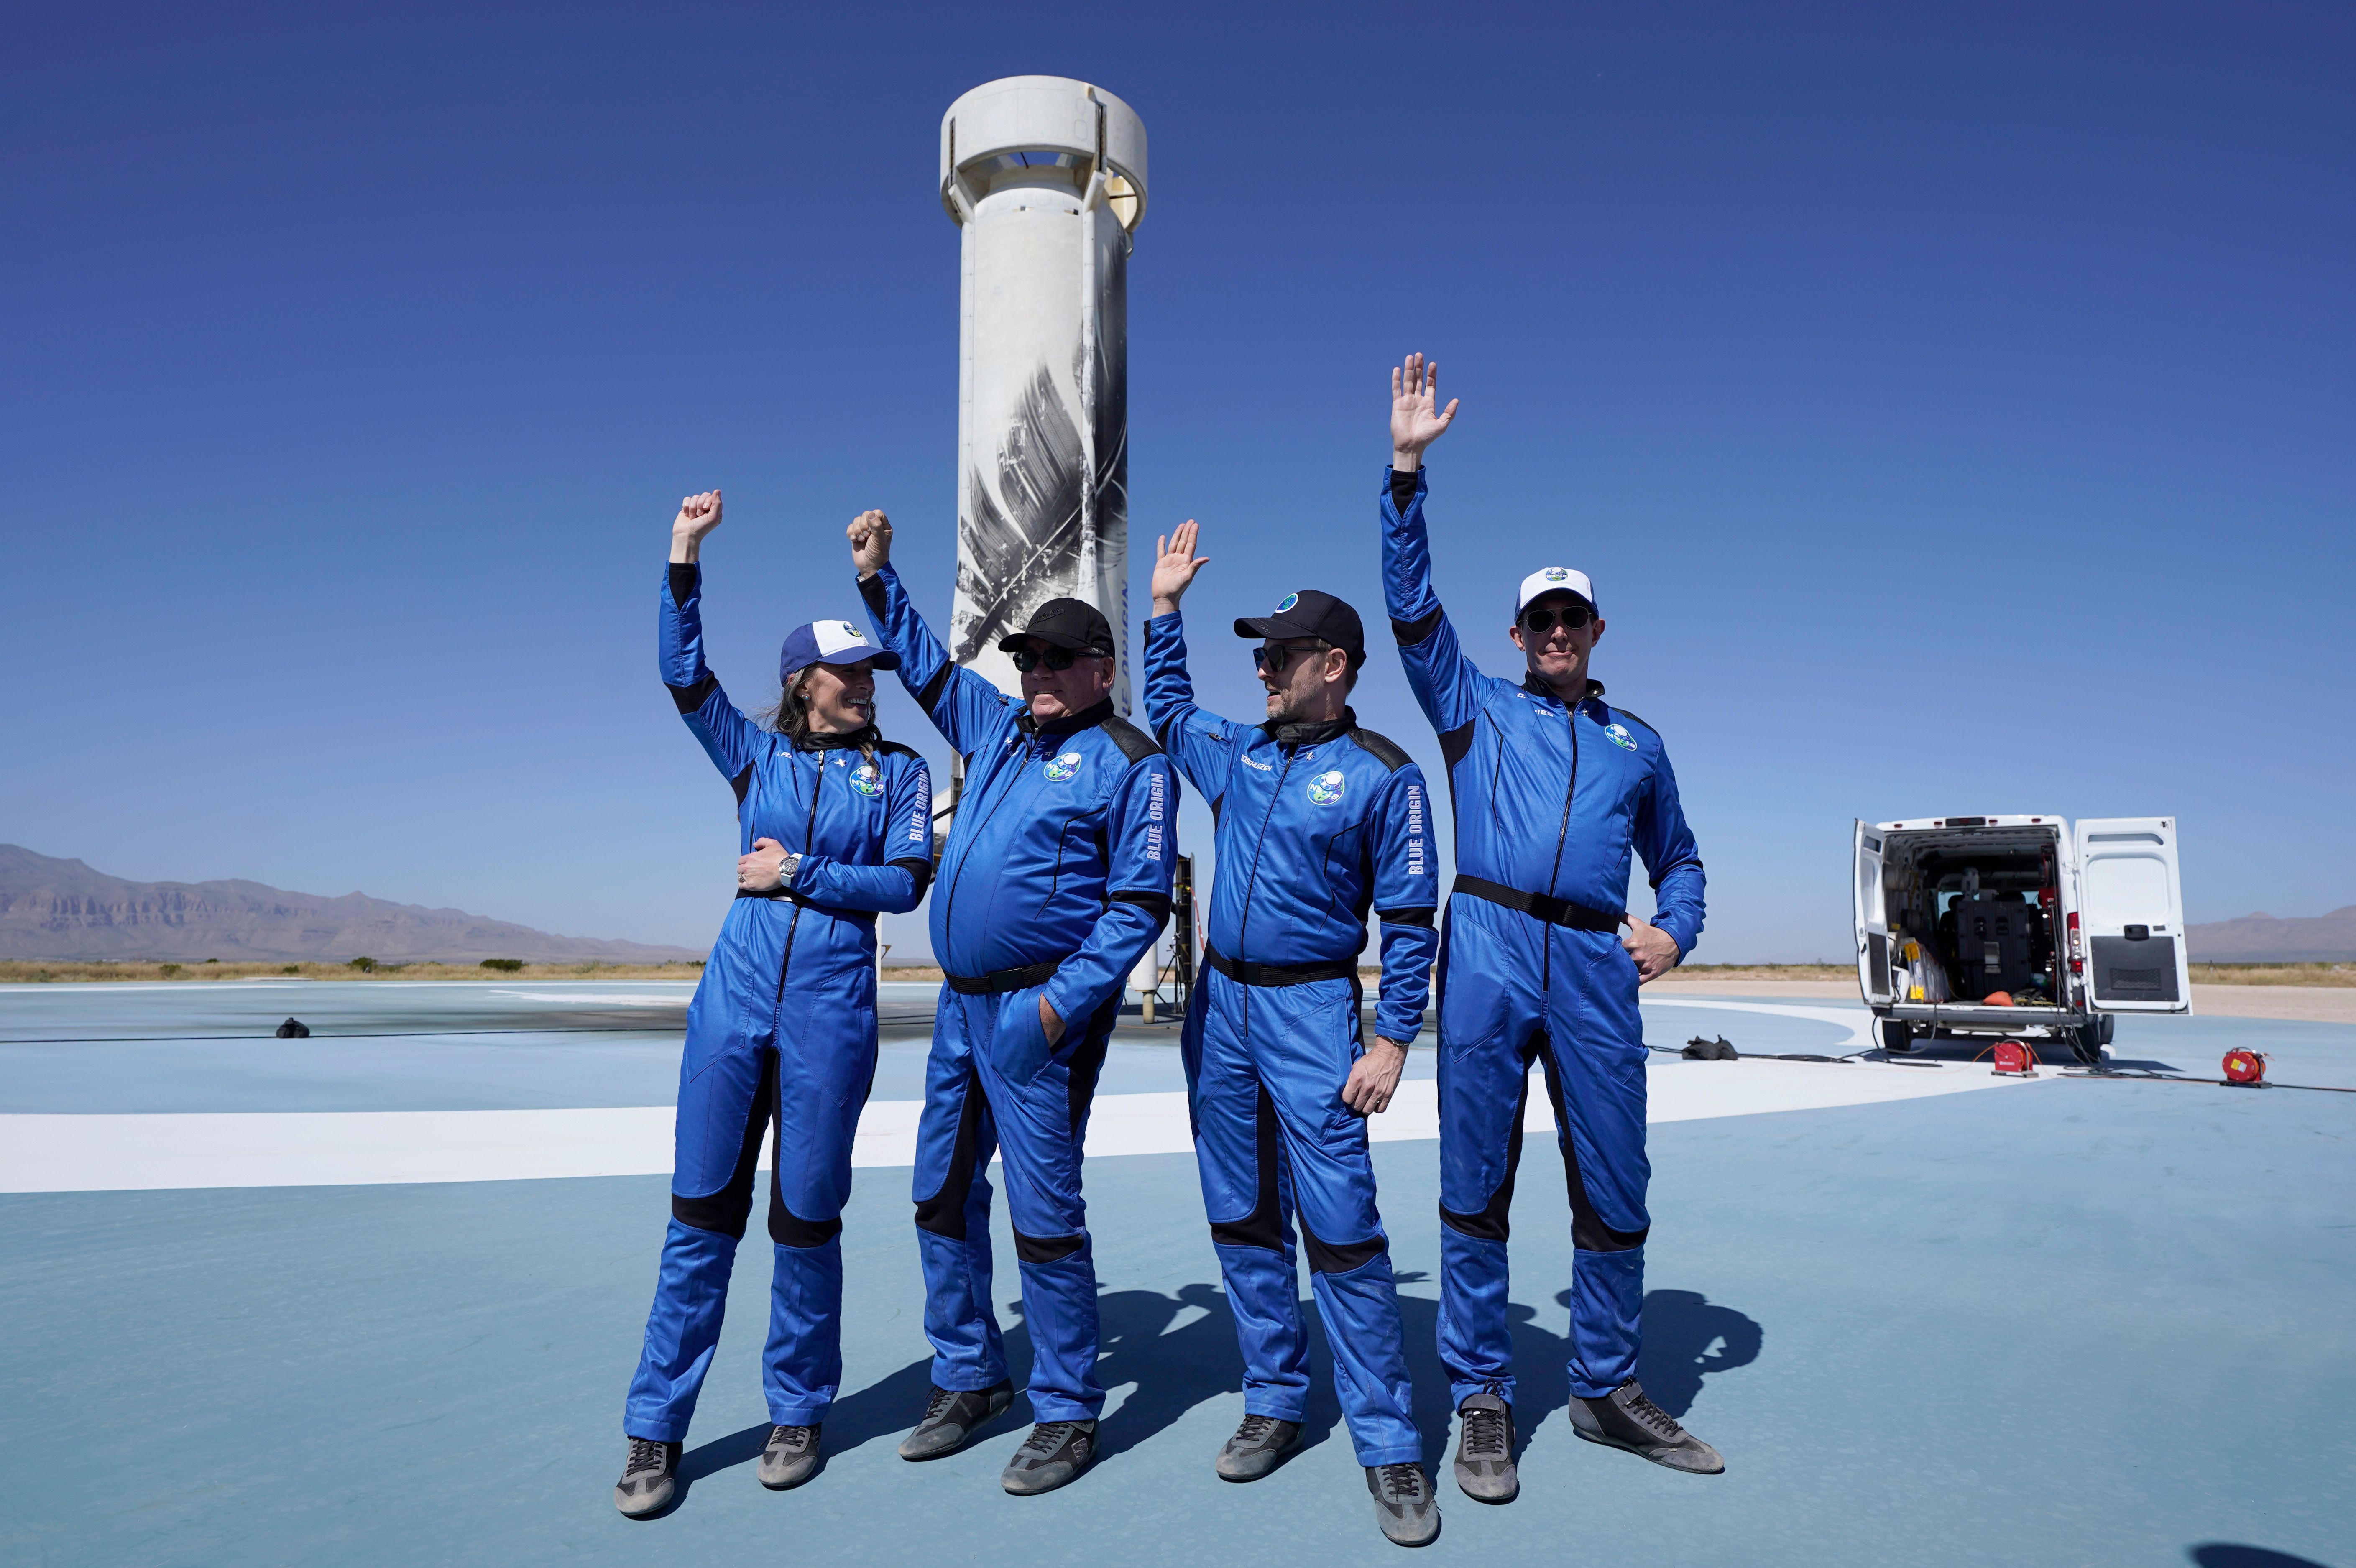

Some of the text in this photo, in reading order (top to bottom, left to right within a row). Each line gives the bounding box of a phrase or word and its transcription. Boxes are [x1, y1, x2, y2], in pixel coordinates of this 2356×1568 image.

[909, 769, 929, 843] BLUE ORIGIN
[1147, 773, 1164, 861] BLUE ORIGIN
[1408, 786, 1424, 875] BLUE ORIGIN
